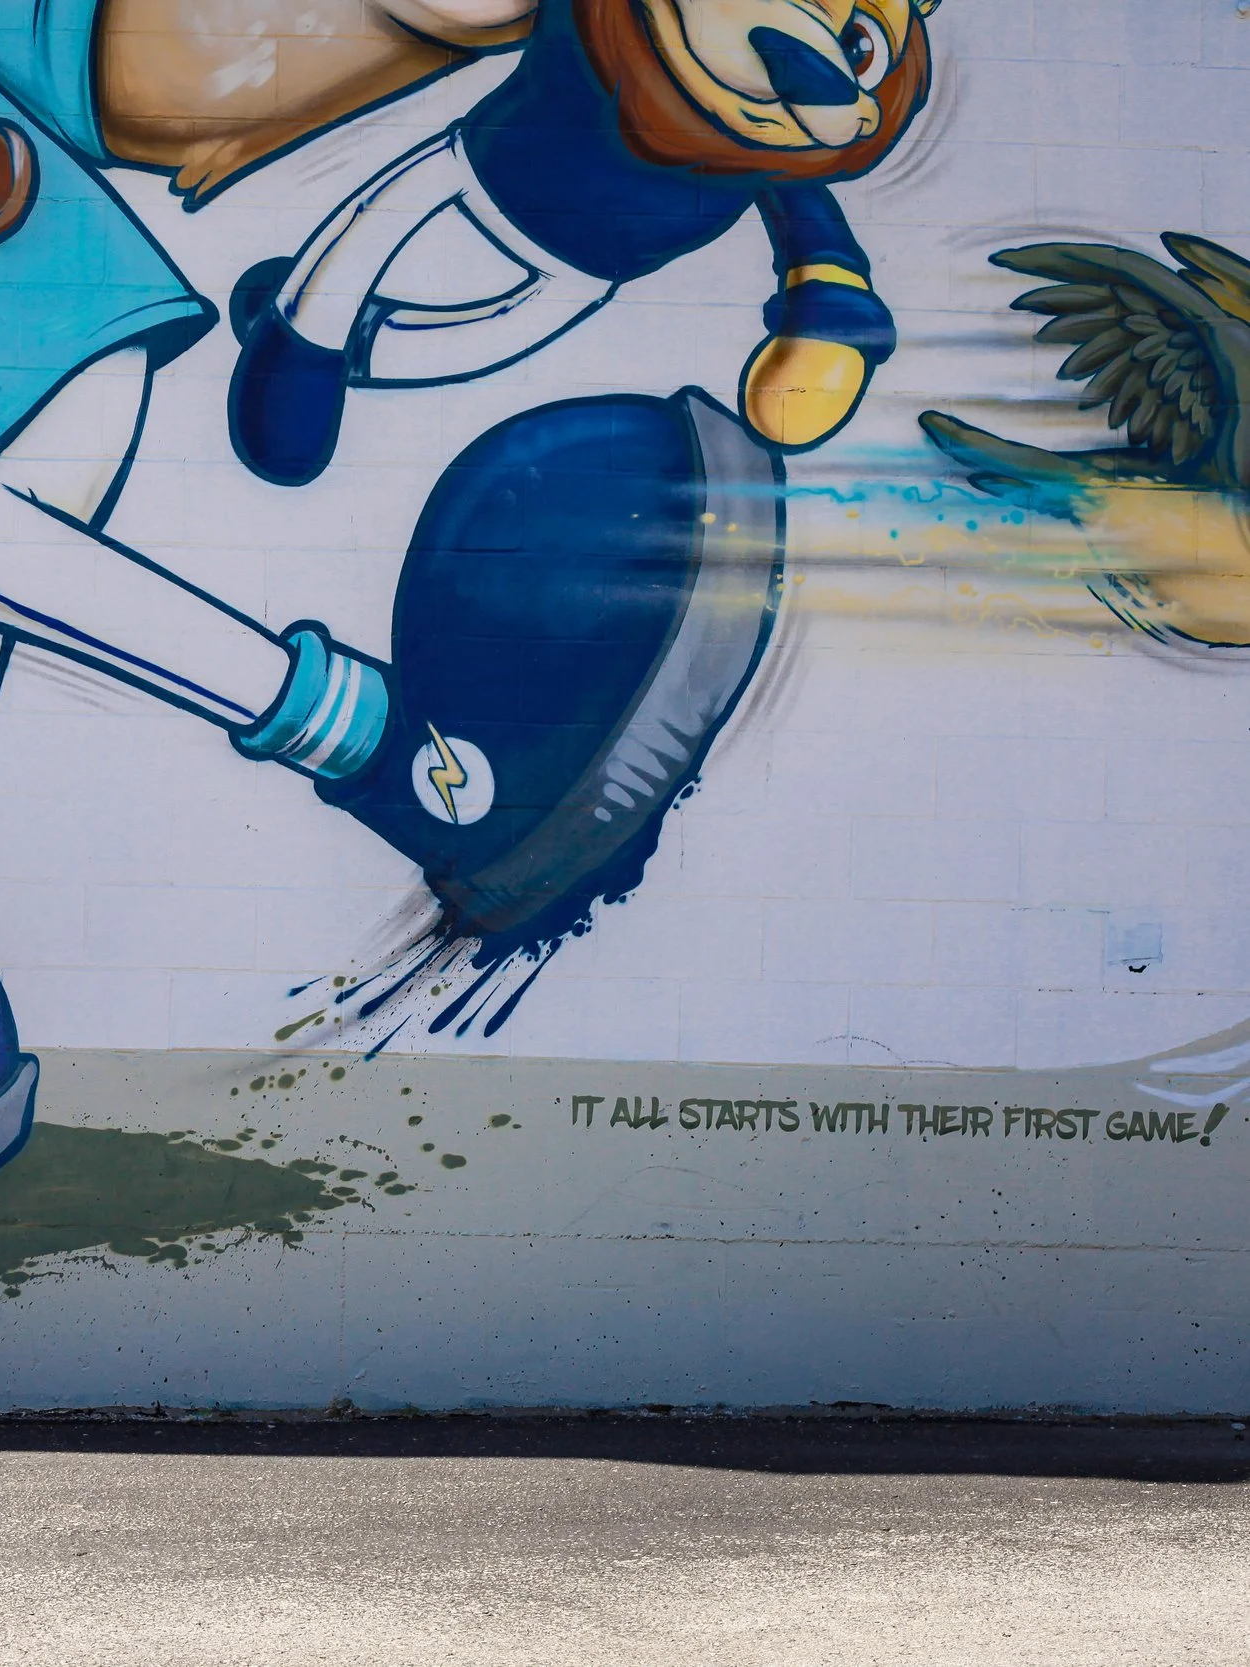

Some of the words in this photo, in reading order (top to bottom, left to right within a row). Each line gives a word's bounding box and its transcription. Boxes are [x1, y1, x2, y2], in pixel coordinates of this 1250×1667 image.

[571, 1095, 605, 1128] IT
[610, 1096, 669, 1130] ALL
[679, 1098, 801, 1134] STARTS
[810, 1102, 888, 1136] WITH
[898, 1103, 994, 1138] THEIR
[1003, 1104, 1100, 1141] FIRST
[1105, 1103, 1231, 1148] GAME!
